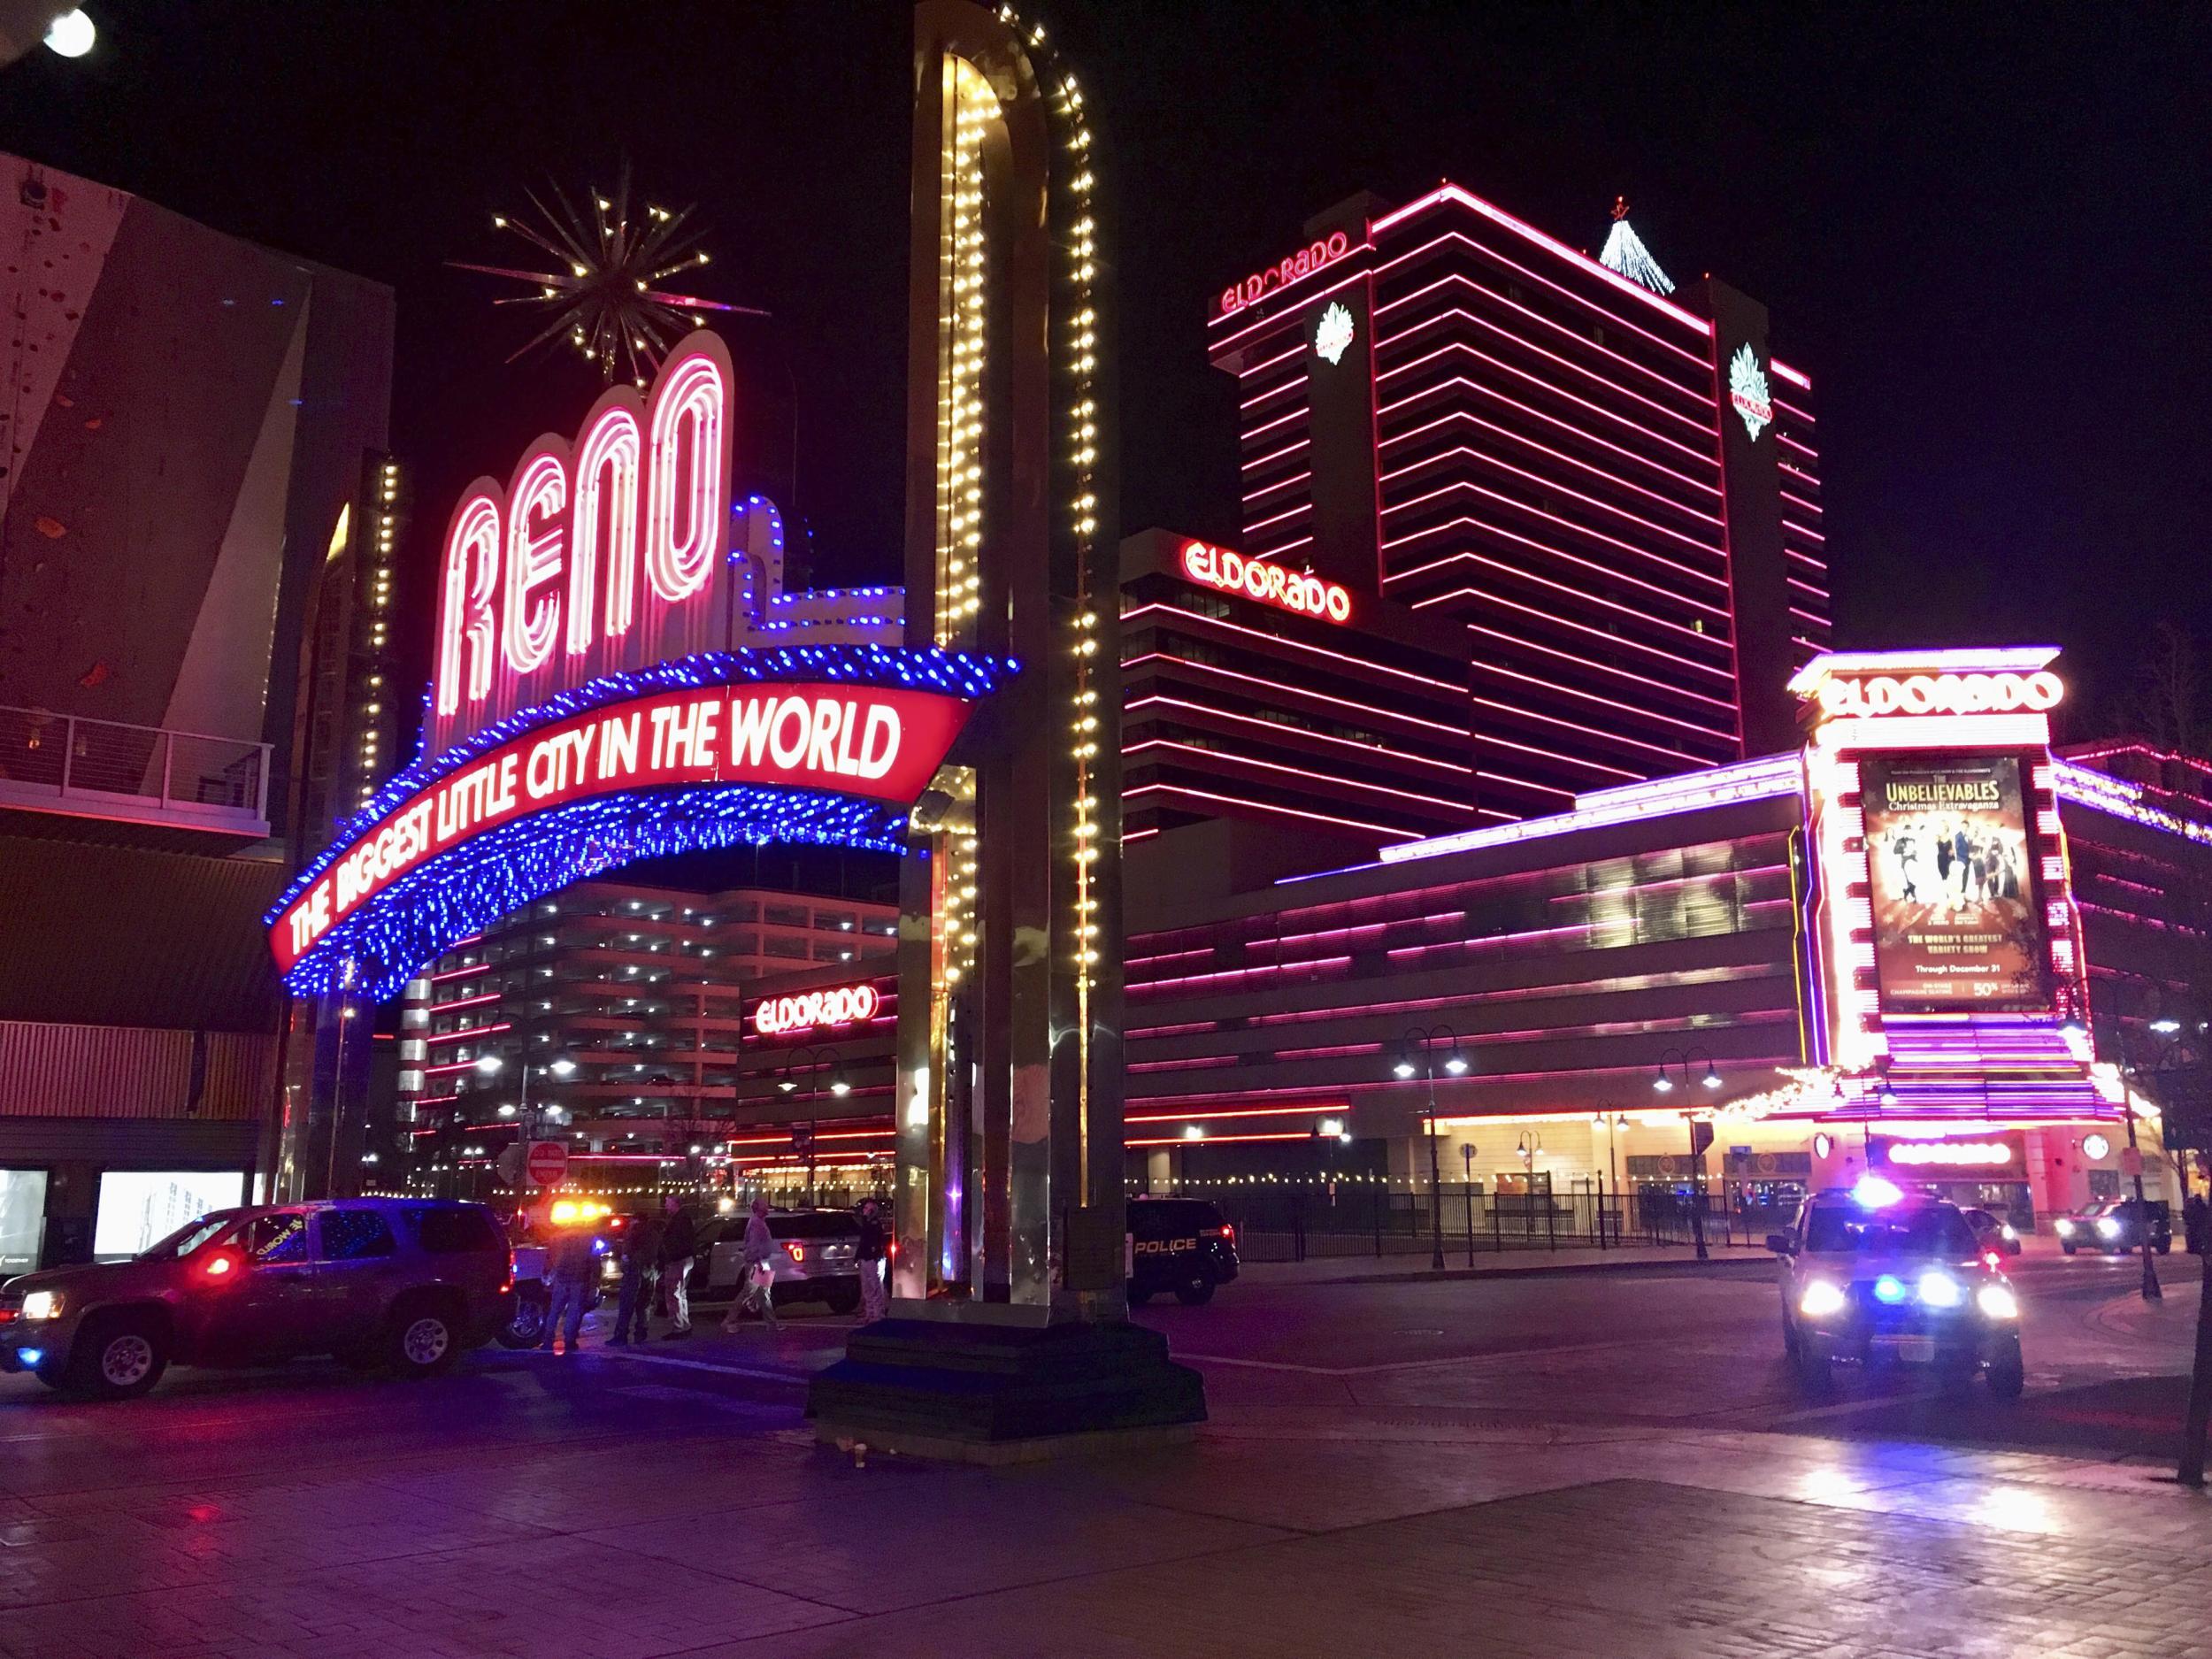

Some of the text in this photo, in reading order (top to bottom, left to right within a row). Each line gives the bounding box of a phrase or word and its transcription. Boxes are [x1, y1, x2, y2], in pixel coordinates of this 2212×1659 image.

[439, 357, 724, 715] RENO
[1186, 542, 1350, 621] ELDORADO
[1886, 780, 2000, 802] UNBELIEVABLES
[1889, 800, 2000, 811] Christmas Extravaganza
[289, 695, 902, 956] THE BIGGEST LITTLE CITY IN THE WORLD
[1908, 934, 2002, 944] THE WORLD'S GREATEST
[1927, 945, 1988, 954] VARIETY SHOW
[1915, 964, 1947, 975] Through
[757, 985, 874, 1033] ELDORADO
[1134, 1239, 1197, 1255] POLICE
